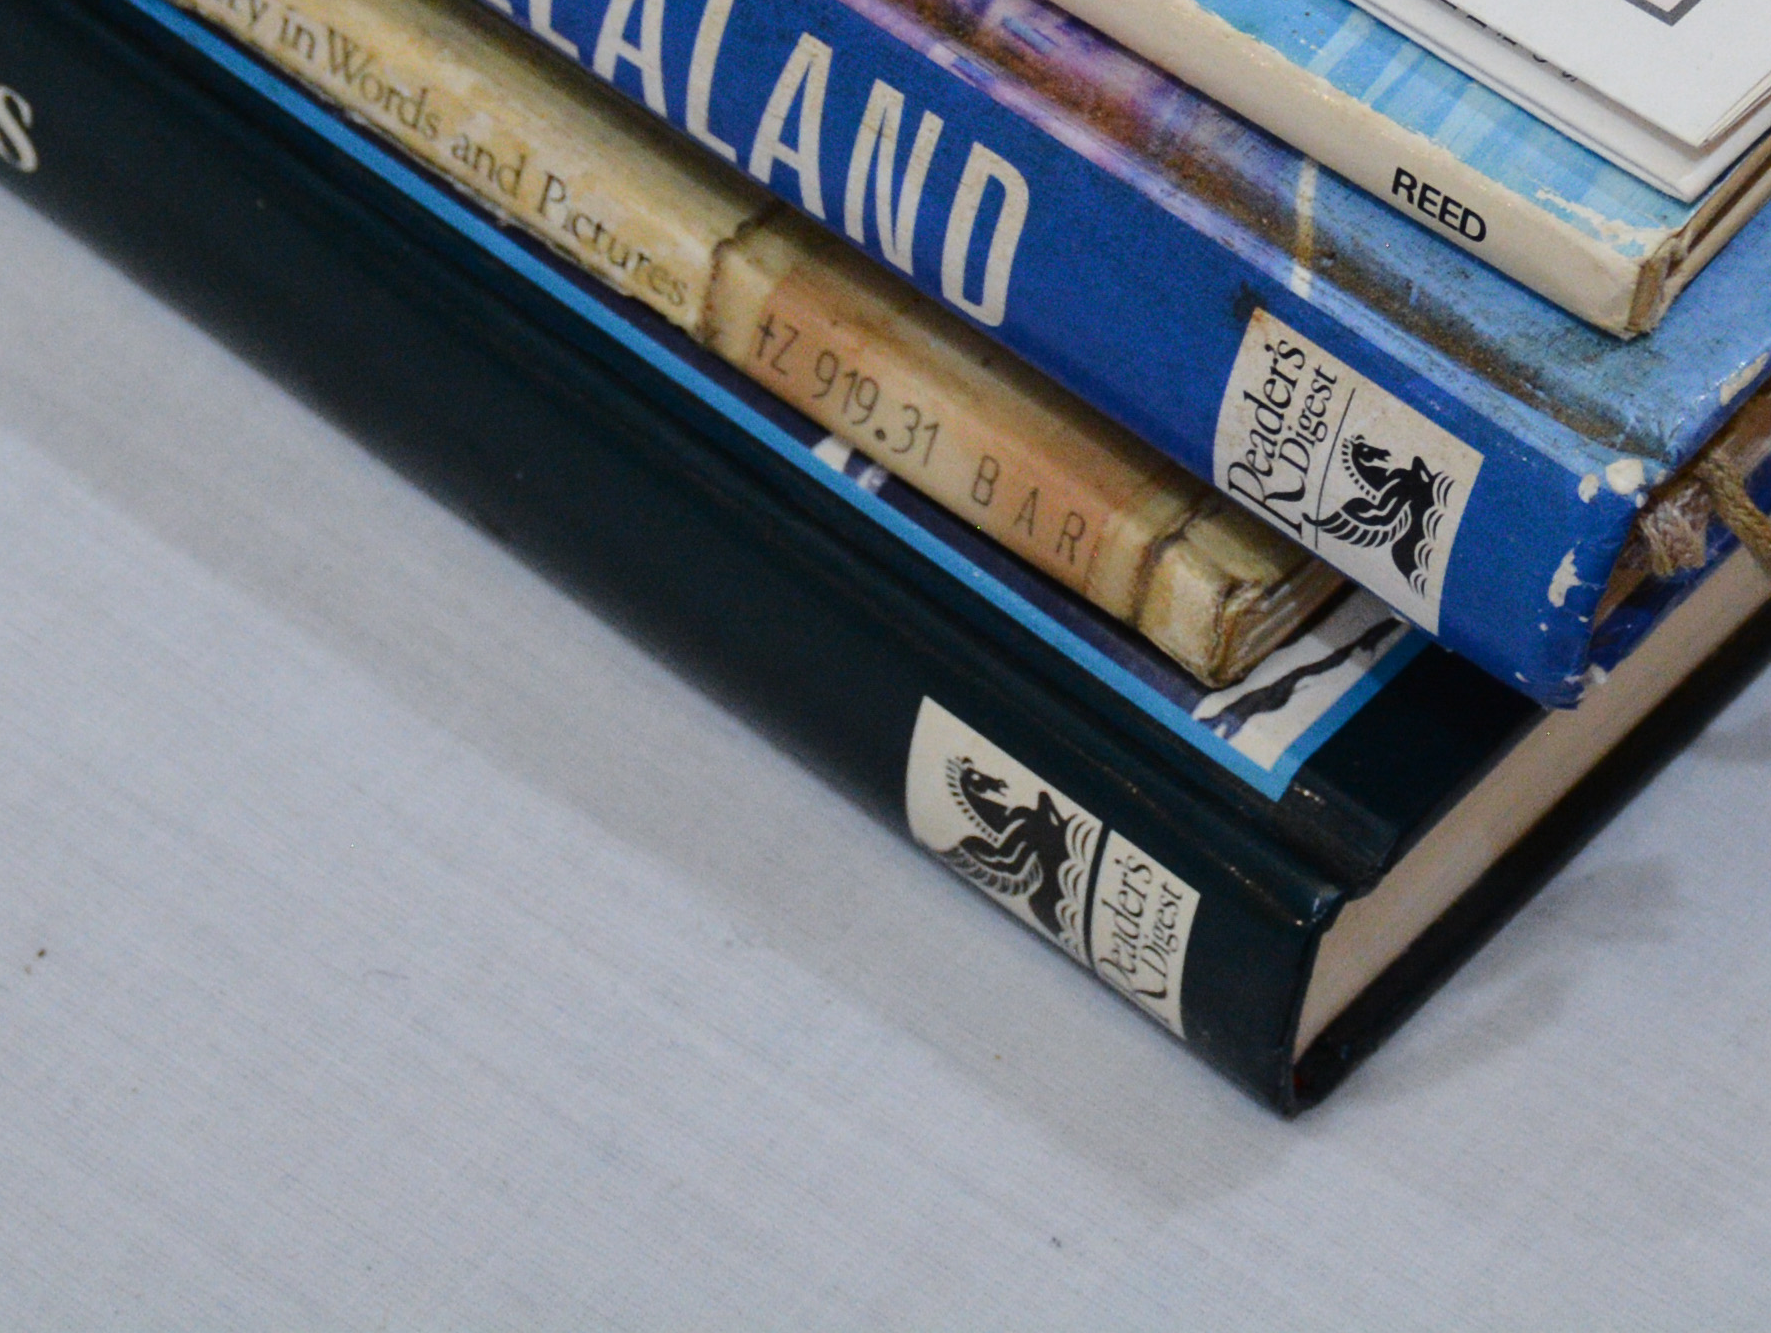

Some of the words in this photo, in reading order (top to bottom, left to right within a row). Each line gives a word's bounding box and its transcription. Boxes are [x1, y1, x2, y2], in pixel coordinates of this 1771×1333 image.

[278, 3, 320, 62] in
[325, 25, 442, 141] Words
[450, 133, 529, 201] and
[536, 173, 690, 309] Pictures
[1391, 166, 1487, 243] REED
[811, 348, 942, 469] 919.31
[1227, 338, 1306, 539] Reader's
[1277, 363, 1338, 479] Digest
[1141, 882, 1183, 979] Digest
